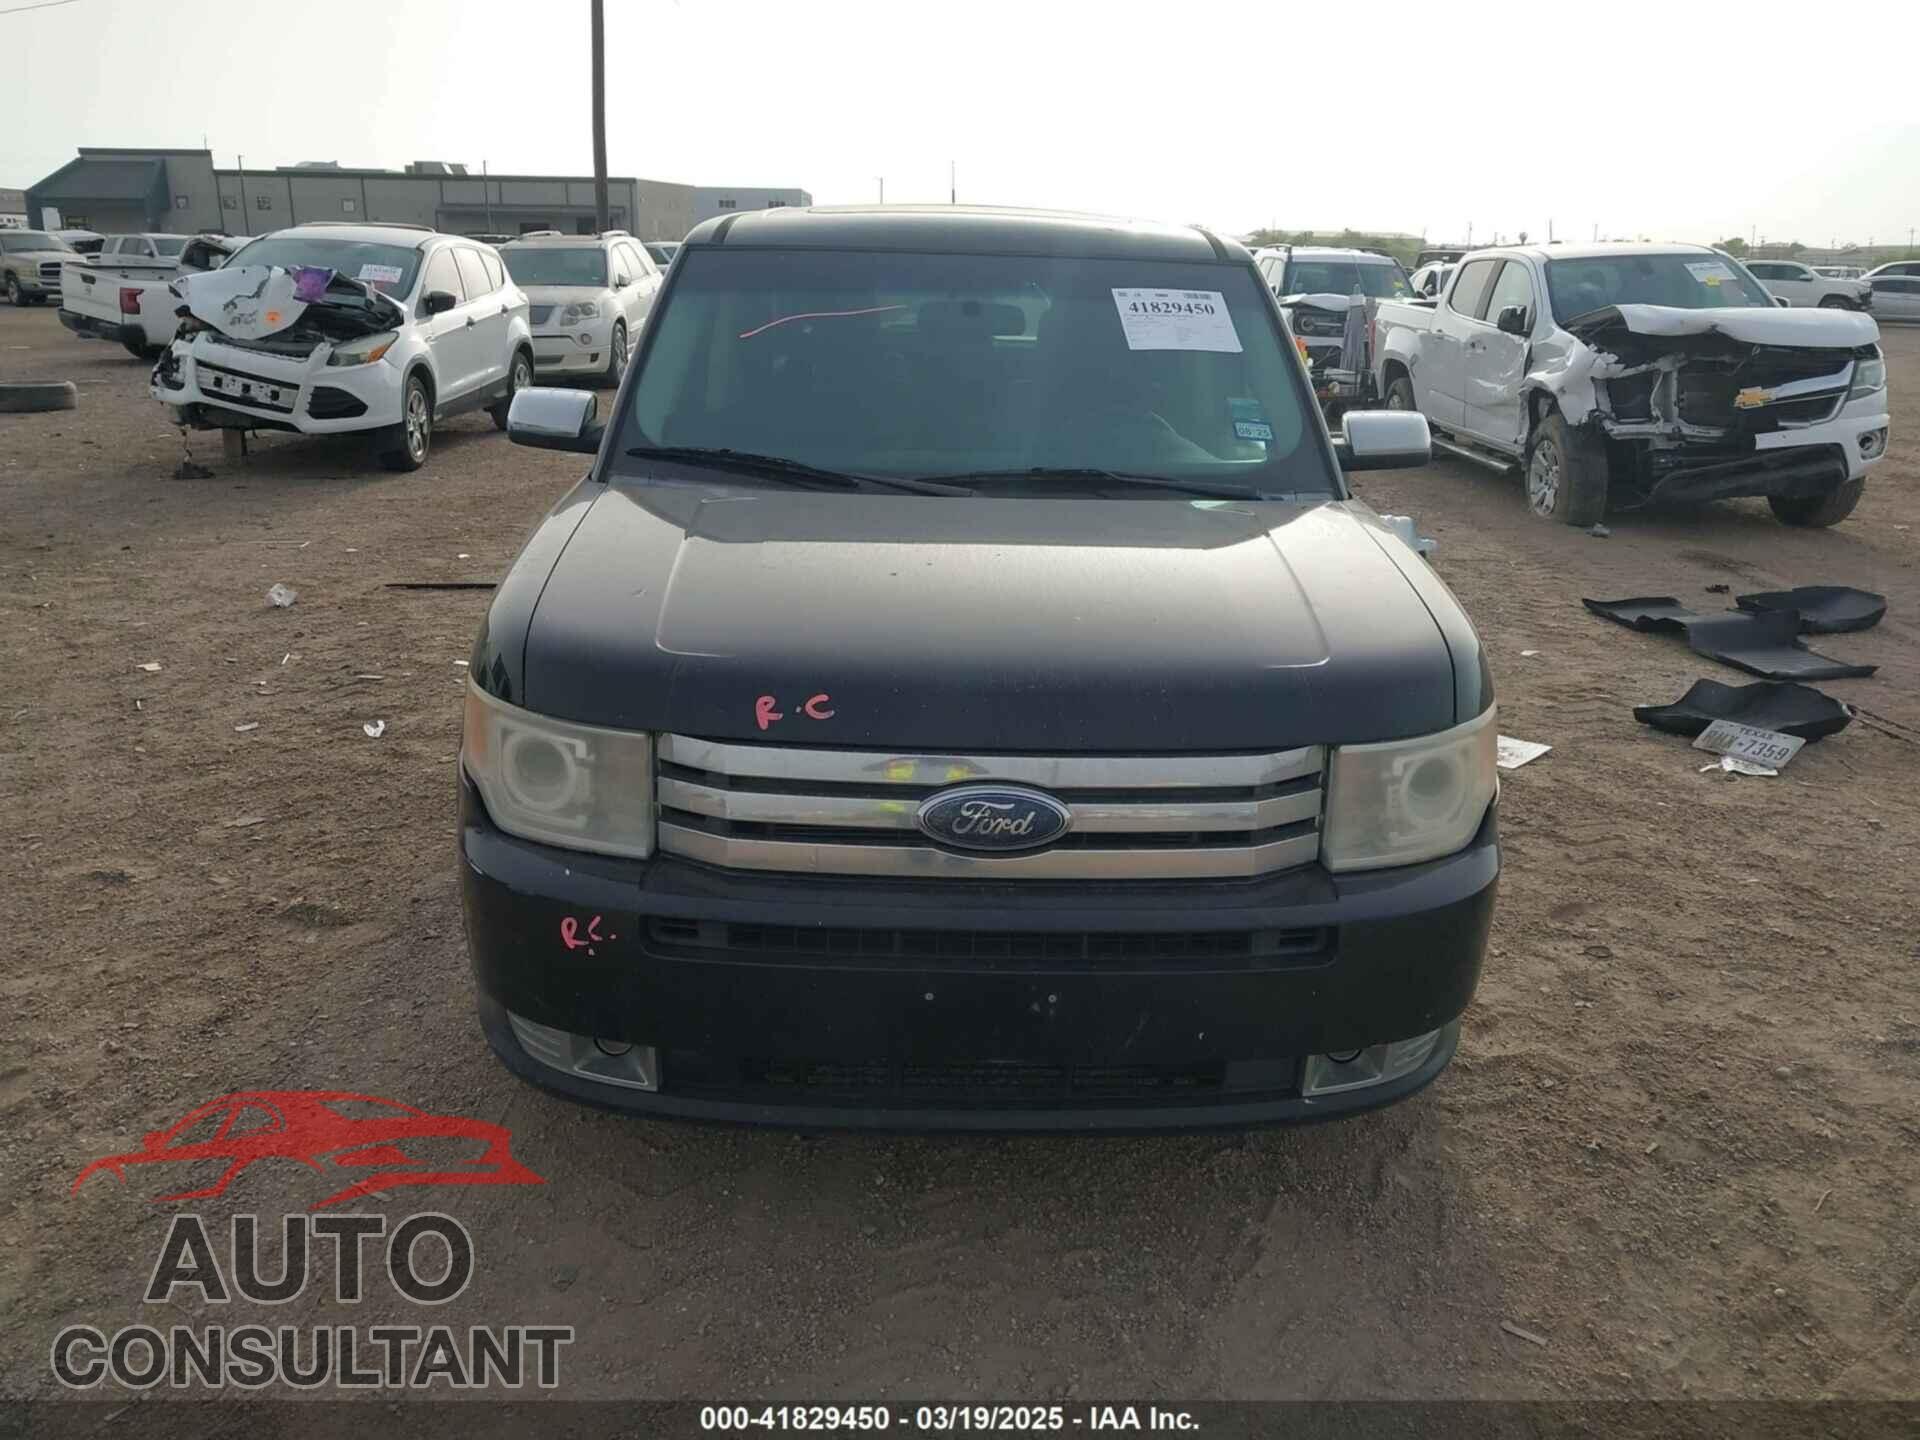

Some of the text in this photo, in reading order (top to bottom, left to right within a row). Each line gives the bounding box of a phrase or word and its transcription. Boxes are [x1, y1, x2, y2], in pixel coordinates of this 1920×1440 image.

[1128, 301, 1215, 315] 41829450
[1740, 727, 1774, 740] TEXAS
[951, 800, 1036, 835] Ford
